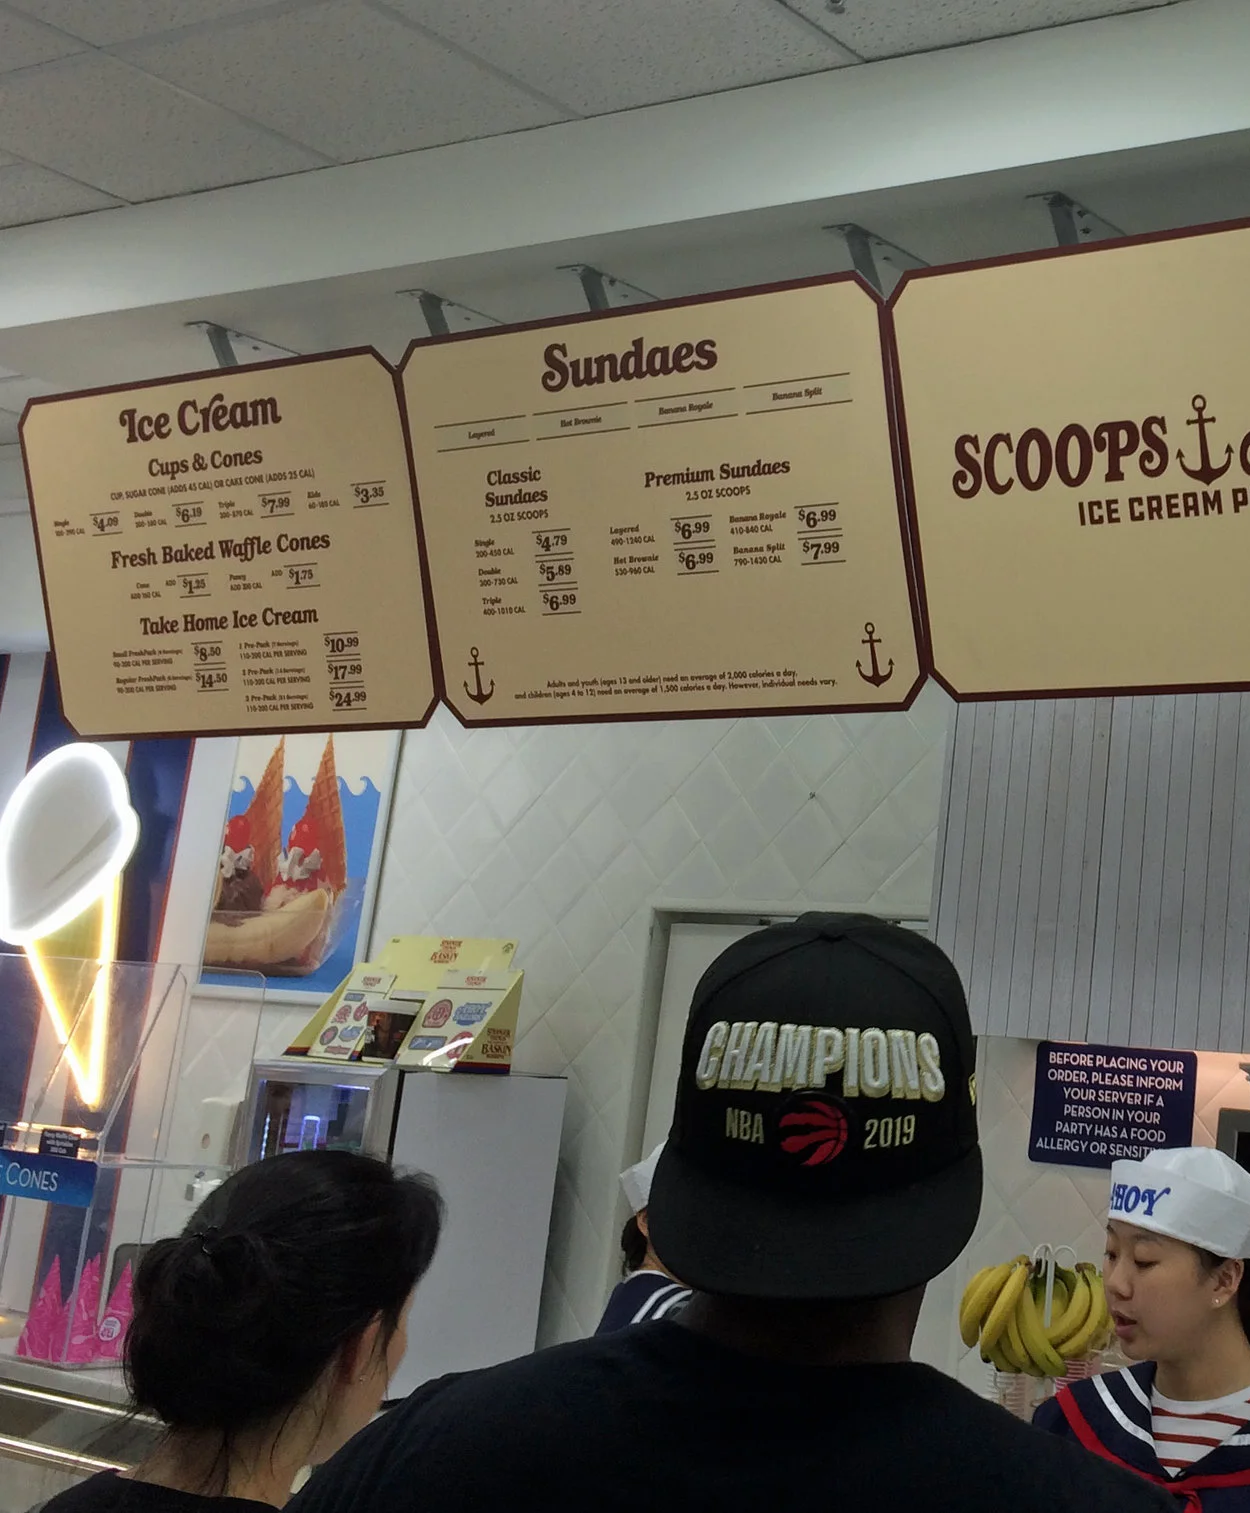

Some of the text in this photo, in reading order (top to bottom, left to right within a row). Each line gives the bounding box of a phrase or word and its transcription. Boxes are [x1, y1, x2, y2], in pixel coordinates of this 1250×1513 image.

[541, 337, 718, 393] Sundaes
[119, 393, 282, 444] Ice Cream
[148, 450, 263, 481] Cups & Cones
[952, 416, 1169, 499] SCOOPS
[487, 466, 541, 486] Classic
[644, 459, 790, 488] Premium Sundaes
[354, 486, 384, 504] $3.35
[485, 488, 548, 508] Sundaes
[262, 497, 290, 514] $7.99
[1078, 499, 1121, 526] ICE
[1128, 490, 1223, 522] CREAM
[798, 509, 836, 528] $6.99
[674, 521, 710, 540] $6.99
[111, 533, 331, 569] Fresh Baked Waffle Cones
[536, 534, 567, 552] $4.79
[802, 541, 840, 560] $7.99
[678, 551, 714, 570] $6.99
[289, 568, 314, 585] $1.75
[539, 563, 572, 582] $5.89
[543, 593, 576, 611] $6.99
[140, 607, 319, 635] Take Home Ice Cream
[194, 645, 221, 662] $8.50
[324, 636, 359, 653] $10.99
[195, 672, 228, 688] $14.50
[328, 663, 362, 680] $17.99
[329, 690, 367, 707] $24.99
[696, 1020, 945, 1103] CHAMPIONS
[1049, 1052, 1184, 1074] BEFORE PLACING YOUR
[1048, 1069, 1183, 1091] ORDER, PLEASE INFORM
[1063, 1087, 1165, 1107] YOUR SERVER IF A
[1064, 1104, 1161, 1125] PERSON IN YOUR
[725, 1107, 915, 1150] NBA 2019
[1055, 1121, 1166, 1143] PARTY HAS A FOOD
[1036, 1136, 1159, 1158] ALLERGY OR SENSIT
[6, 1162, 58, 1191] CONES
